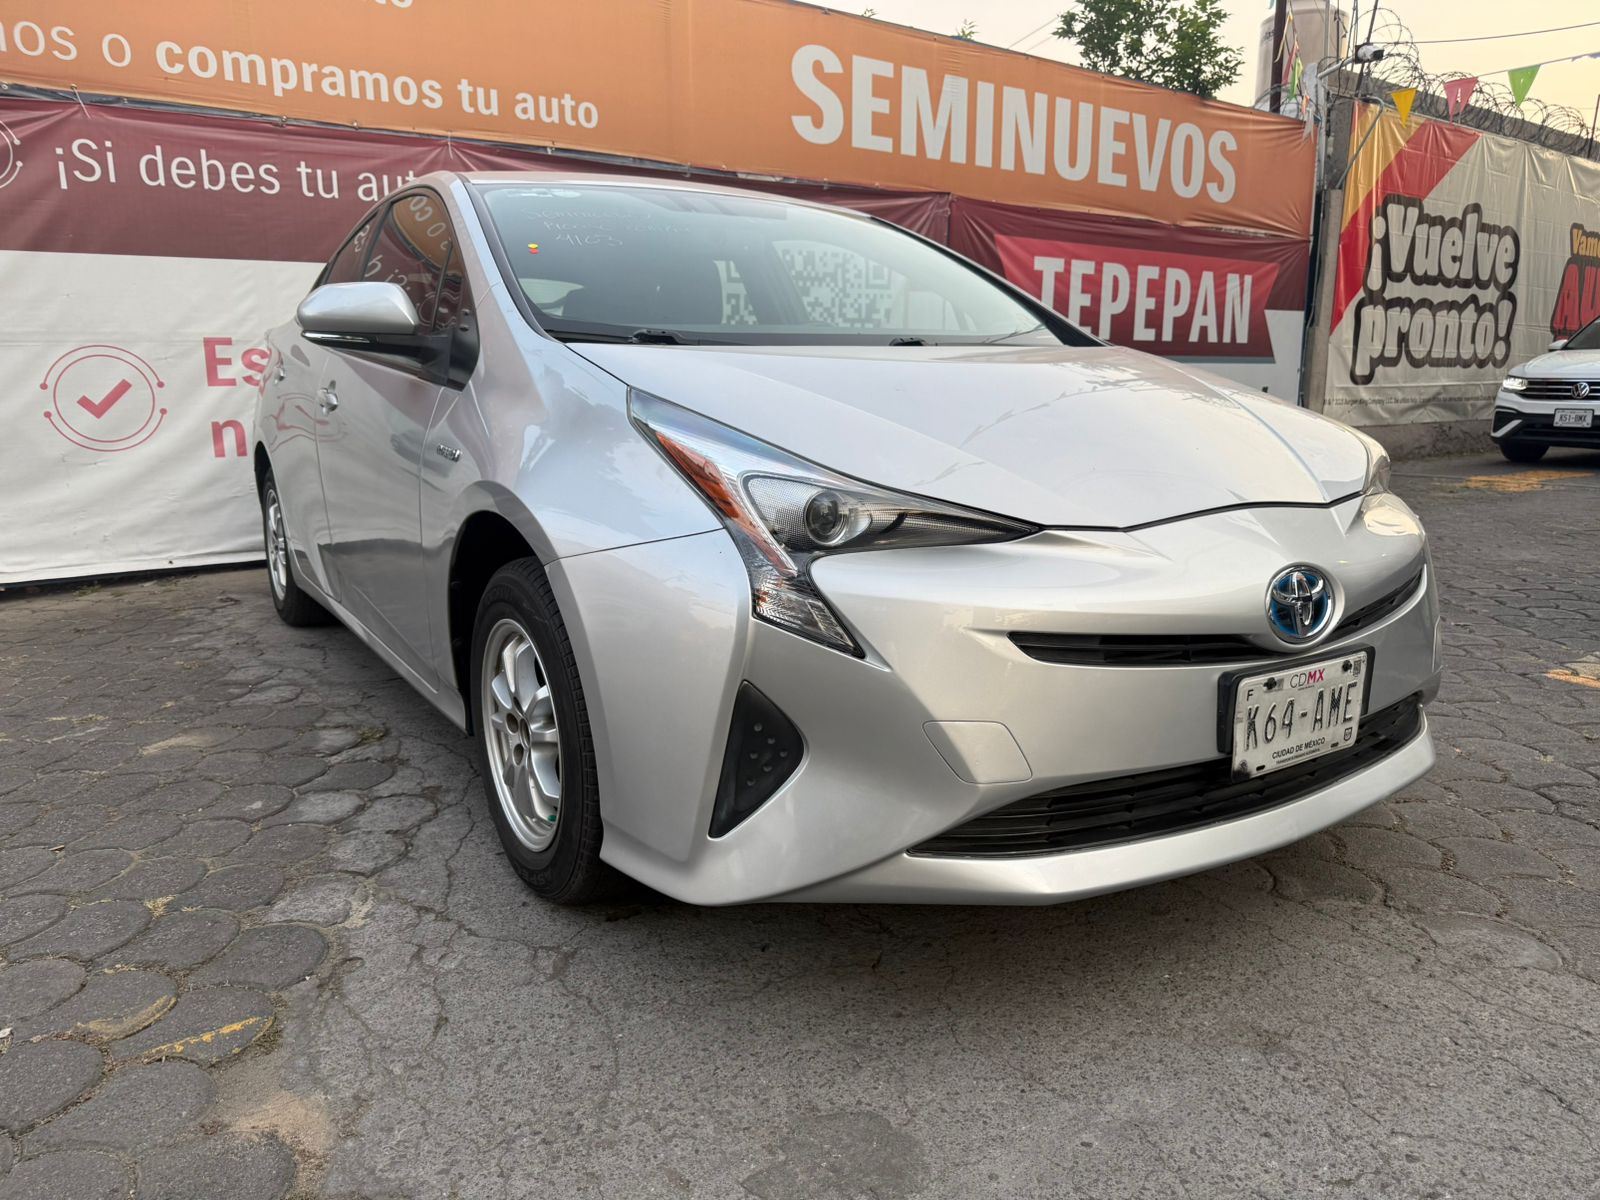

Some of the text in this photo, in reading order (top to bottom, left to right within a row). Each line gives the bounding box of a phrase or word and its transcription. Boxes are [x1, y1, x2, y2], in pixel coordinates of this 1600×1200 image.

[0, 20, 599, 129] os o compramos tu auto
[790, 44, 1237, 204] SEMINUEVOS
[55, 138, 116, 190] ¡Si
[139, 145, 281, 195] debes
[296, 161, 340, 199] tu
[1365, 199, 1518, 294] ¡Vuelve
[1033, 255, 1252, 344] TEPEPAN
[1352, 295, 1515, 380] pronto!
[1244, 681, 1358, 751] K64-AME
[1290, 668, 1325, 689] CDMX
[1272, 746, 1294, 760] CIUDAD
[1295, 744, 1303, 752] DE
[1304, 737, 1326, 749] MÉXICO
